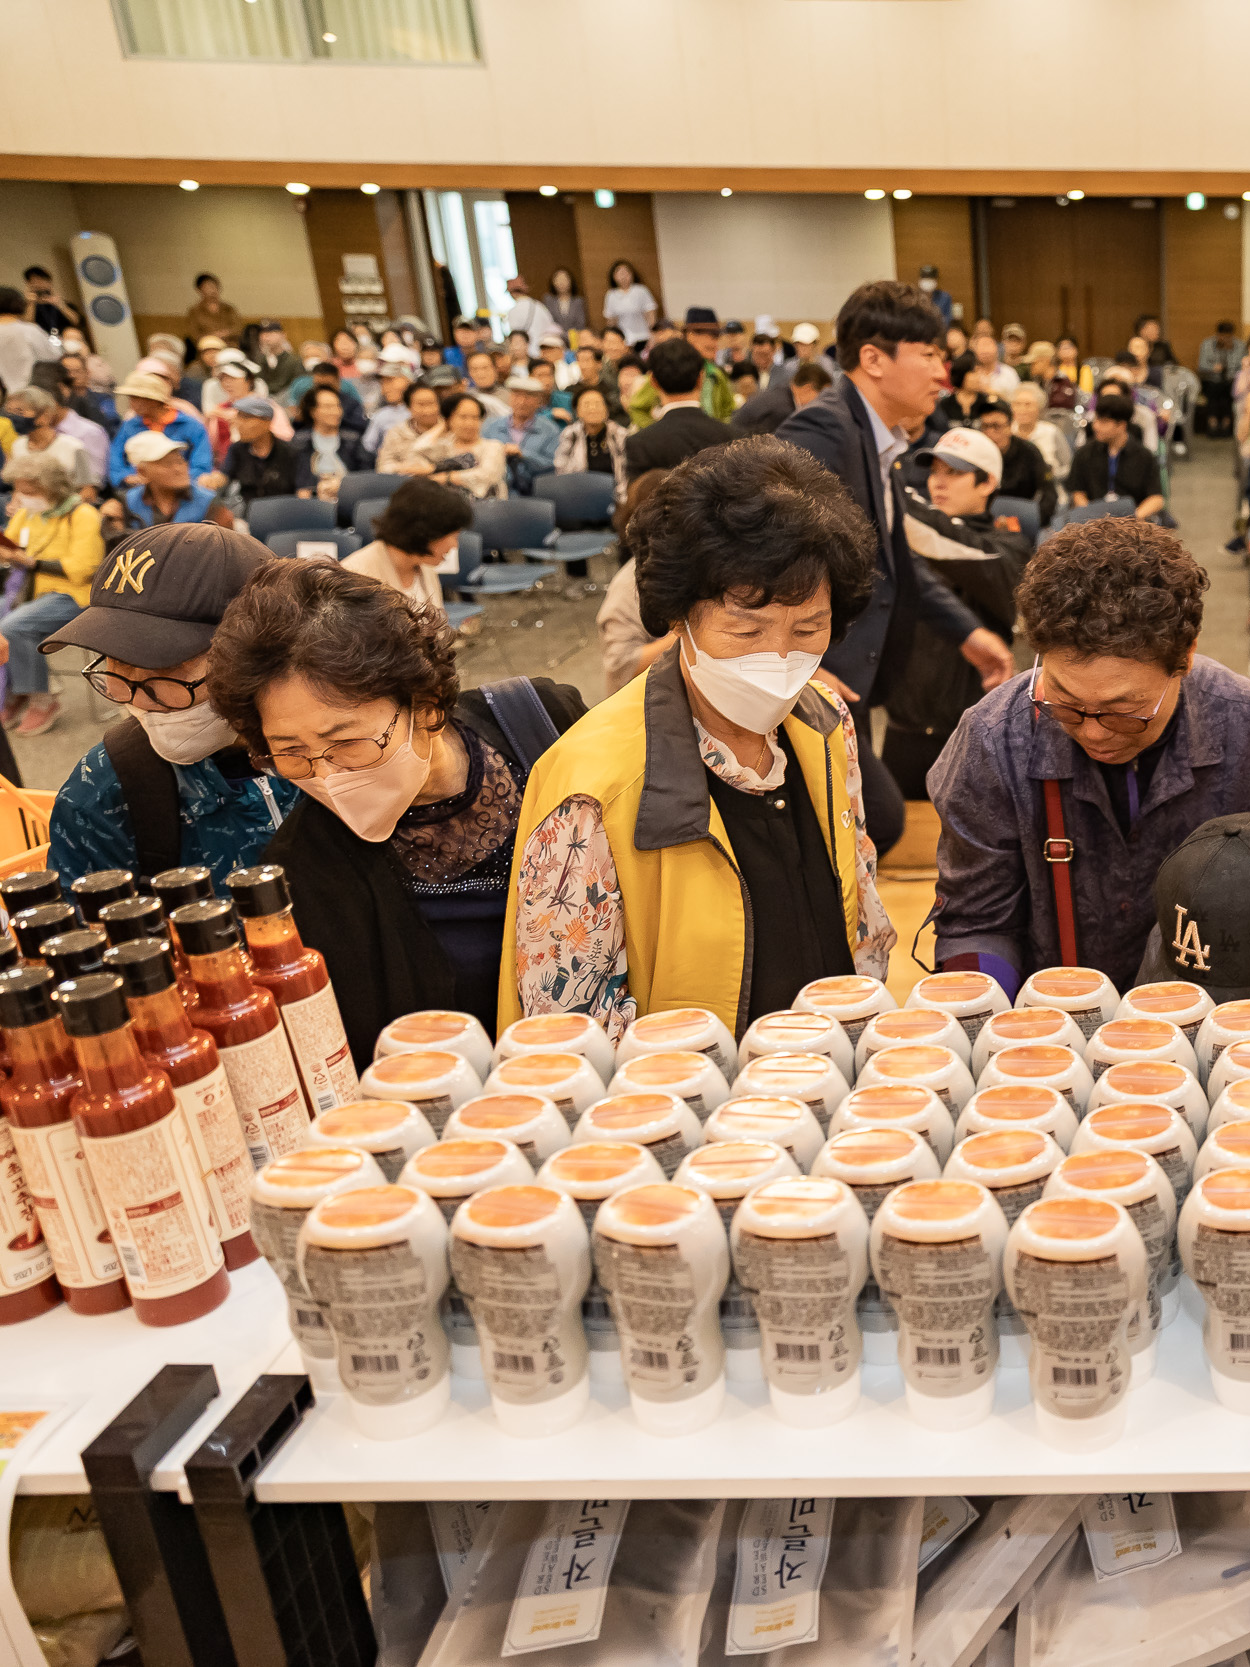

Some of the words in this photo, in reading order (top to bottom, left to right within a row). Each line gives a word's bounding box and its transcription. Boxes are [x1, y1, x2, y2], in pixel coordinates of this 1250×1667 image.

[101, 548, 155, 594] NY
[1172, 904, 1211, 971] LA
[1115, 1543, 1142, 1559] Brand
[1143, 1541, 1157, 1550] No
